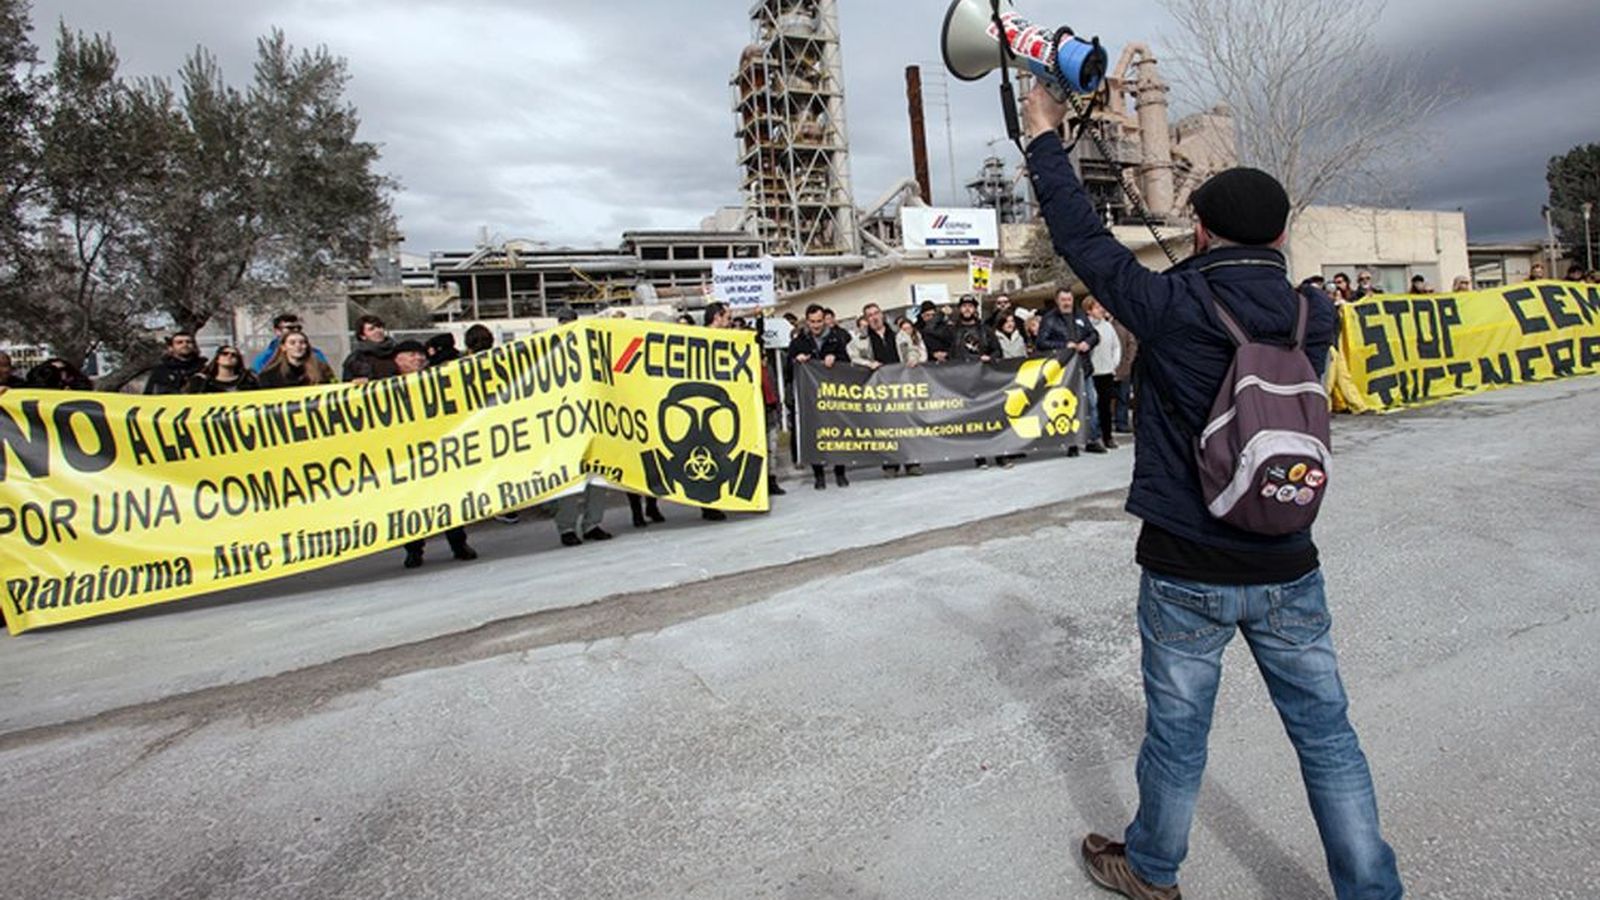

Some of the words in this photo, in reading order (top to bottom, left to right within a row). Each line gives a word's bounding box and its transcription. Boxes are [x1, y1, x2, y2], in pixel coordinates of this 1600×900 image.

[1354, 298, 1462, 374] STOP
[0, 399, 117, 482] NO
[126, 406, 157, 466] A
[152, 407, 200, 463] LA
[201, 375, 415, 457] INCINERACION
[417, 366, 458, 420] DE
[459, 329, 583, 412] RESIDUOS
[585, 328, 615, 387] EN
[644, 332, 754, 384] CEMEX
[816, 400, 863, 413] QUIERE
[864, 401, 882, 413] SU
[884, 401, 914, 413] AIRE
[817, 382, 929, 400] ¡MACASTRE
[816, 440, 898, 452] CEMENTERA!
[817, 426, 840, 440] ¡NO
[843, 426, 853, 438] A
[855, 426, 873, 439] LA
[965, 422, 983, 434] EN
[985, 420, 1004, 432] LA
[0, 498, 78, 547] POR
[92, 484, 182, 536] UNA
[193, 452, 380, 521] COMARCA
[386, 430, 483, 485] LIBRE
[490, 416, 531, 459] DE
[535, 396, 650, 444] TÓXICOS
[6, 556, 194, 616] Plataforma
[213, 541, 272, 581] Aire
[281, 519, 378, 566] Limpio
[387, 502, 451, 541] Hoya
[461, 491, 493, 521] de
